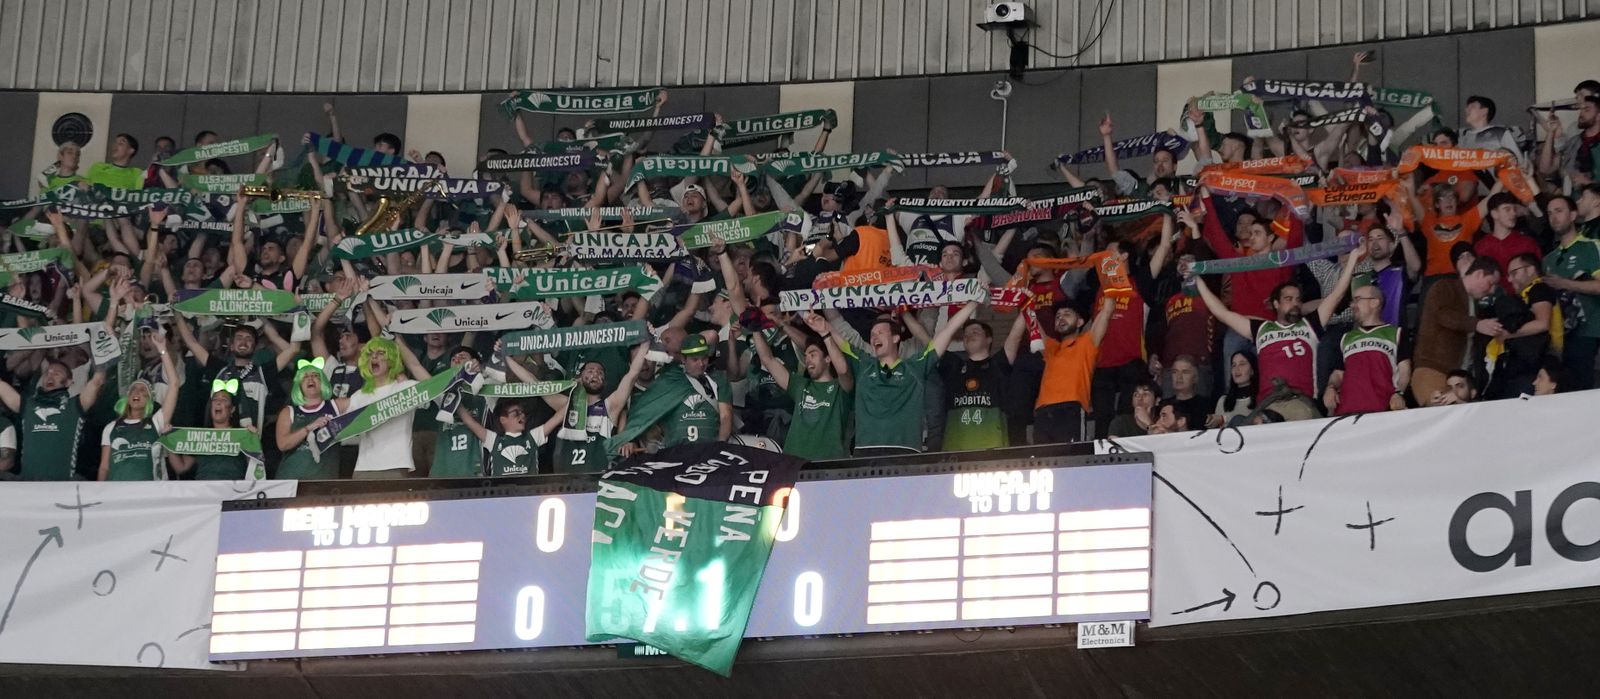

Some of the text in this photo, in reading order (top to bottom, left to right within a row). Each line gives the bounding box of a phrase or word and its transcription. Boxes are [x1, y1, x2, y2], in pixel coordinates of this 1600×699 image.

[1264, 79, 1363, 98] UNICAJA
[556, 94, 633, 111] Unicaja
[1371, 87, 1433, 107] icaja
[609, 114, 704, 129] UNICAJA BALONCESTO
[736, 112, 814, 133] Unicaja
[195, 143, 249, 160] BALONCESTO
[898, 151, 982, 166] NICAJA
[1422, 148, 1511, 160] VALENCIA BAS
[486, 157, 523, 170] UNICAJA
[523, 154, 581, 168] BALONCESTO
[643, 158, 728, 173] Unicaja
[801, 151, 880, 169] Unicaja
[198, 174, 256, 185] BALONCESTO
[207, 182, 242, 192] NICAJA
[373, 177, 479, 194] UNICAJA
[111, 188, 194, 206] Unicaja
[899, 197, 925, 206] CLUB
[926, 198, 976, 207] JOVENTUT
[1324, 192, 1377, 203] Esfuerzo
[271, 199, 312, 211] BALONC
[561, 206, 597, 217] UNICAJ
[600, 206, 652, 217] BALOESTO
[702, 220, 741, 234] UNICAJA
[573, 233, 669, 248] UNICAJA
[536, 270, 632, 292] Unicaja
[219, 290, 264, 301] UNICAJA
[419, 285, 454, 296] Unicaja
[828, 280, 935, 298] UNICAJA
[209, 300, 273, 313] BALONCESTO
[858, 294, 933, 308] MALAGA
[454, 316, 489, 328] Unicaja
[44, 331, 78, 342] Unicaja
[520, 326, 626, 351] UNICAJA BALONCESTO
[1282, 341, 1306, 358] 15
[494, 381, 563, 396] BALONCESTO
[376, 387, 418, 412] UNICAJA
[370, 390, 429, 426] BALONCESTO
[961, 408, 983, 425] 44
[187, 431, 231, 443] UNICAJA
[687, 425, 699, 442] 9
[176, 441, 241, 454] BALONCESTO
[451, 433, 467, 451] 12
[571, 449, 586, 465] 22
[718, 470, 769, 542] PEÑA
[536, 497, 566, 553] 0
[793, 571, 823, 627] 0
[514, 585, 545, 640] 0
[1082, 624, 1126, 637] M&M
[1081, 636, 1126, 647] Electronics
